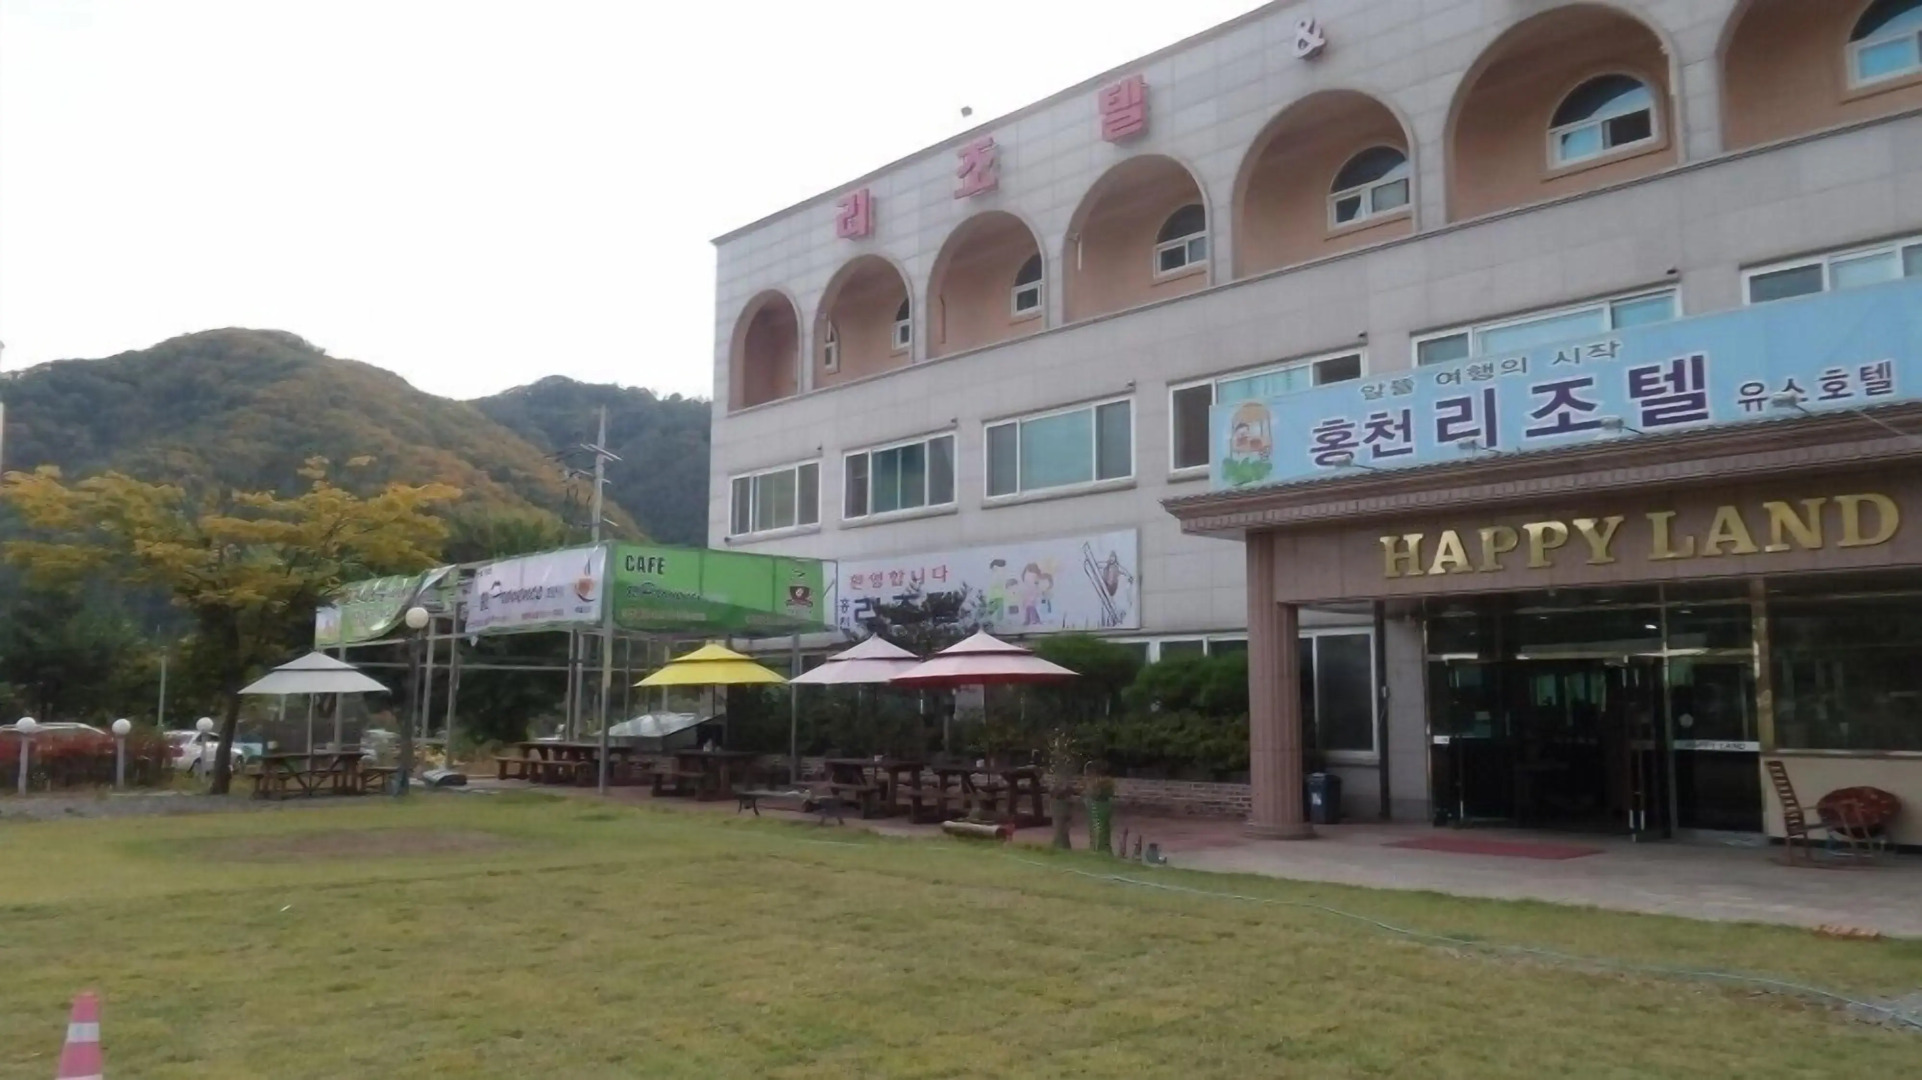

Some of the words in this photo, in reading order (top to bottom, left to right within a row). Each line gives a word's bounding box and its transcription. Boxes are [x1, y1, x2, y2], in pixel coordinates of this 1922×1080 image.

[1296, 18, 1327, 60] &
[1435, 356, 1527, 386] 여행의
[1551, 339, 1621, 366] 시작
[1309, 408, 1414, 467] 홍천
[1432, 354, 1709, 449] 리조텔
[1737, 360, 1894, 412] 유스호텔
[1379, 515, 1625, 579] HAPPY
[1645, 493, 1900, 561] LAND
[624, 554, 666, 576] CAFE
